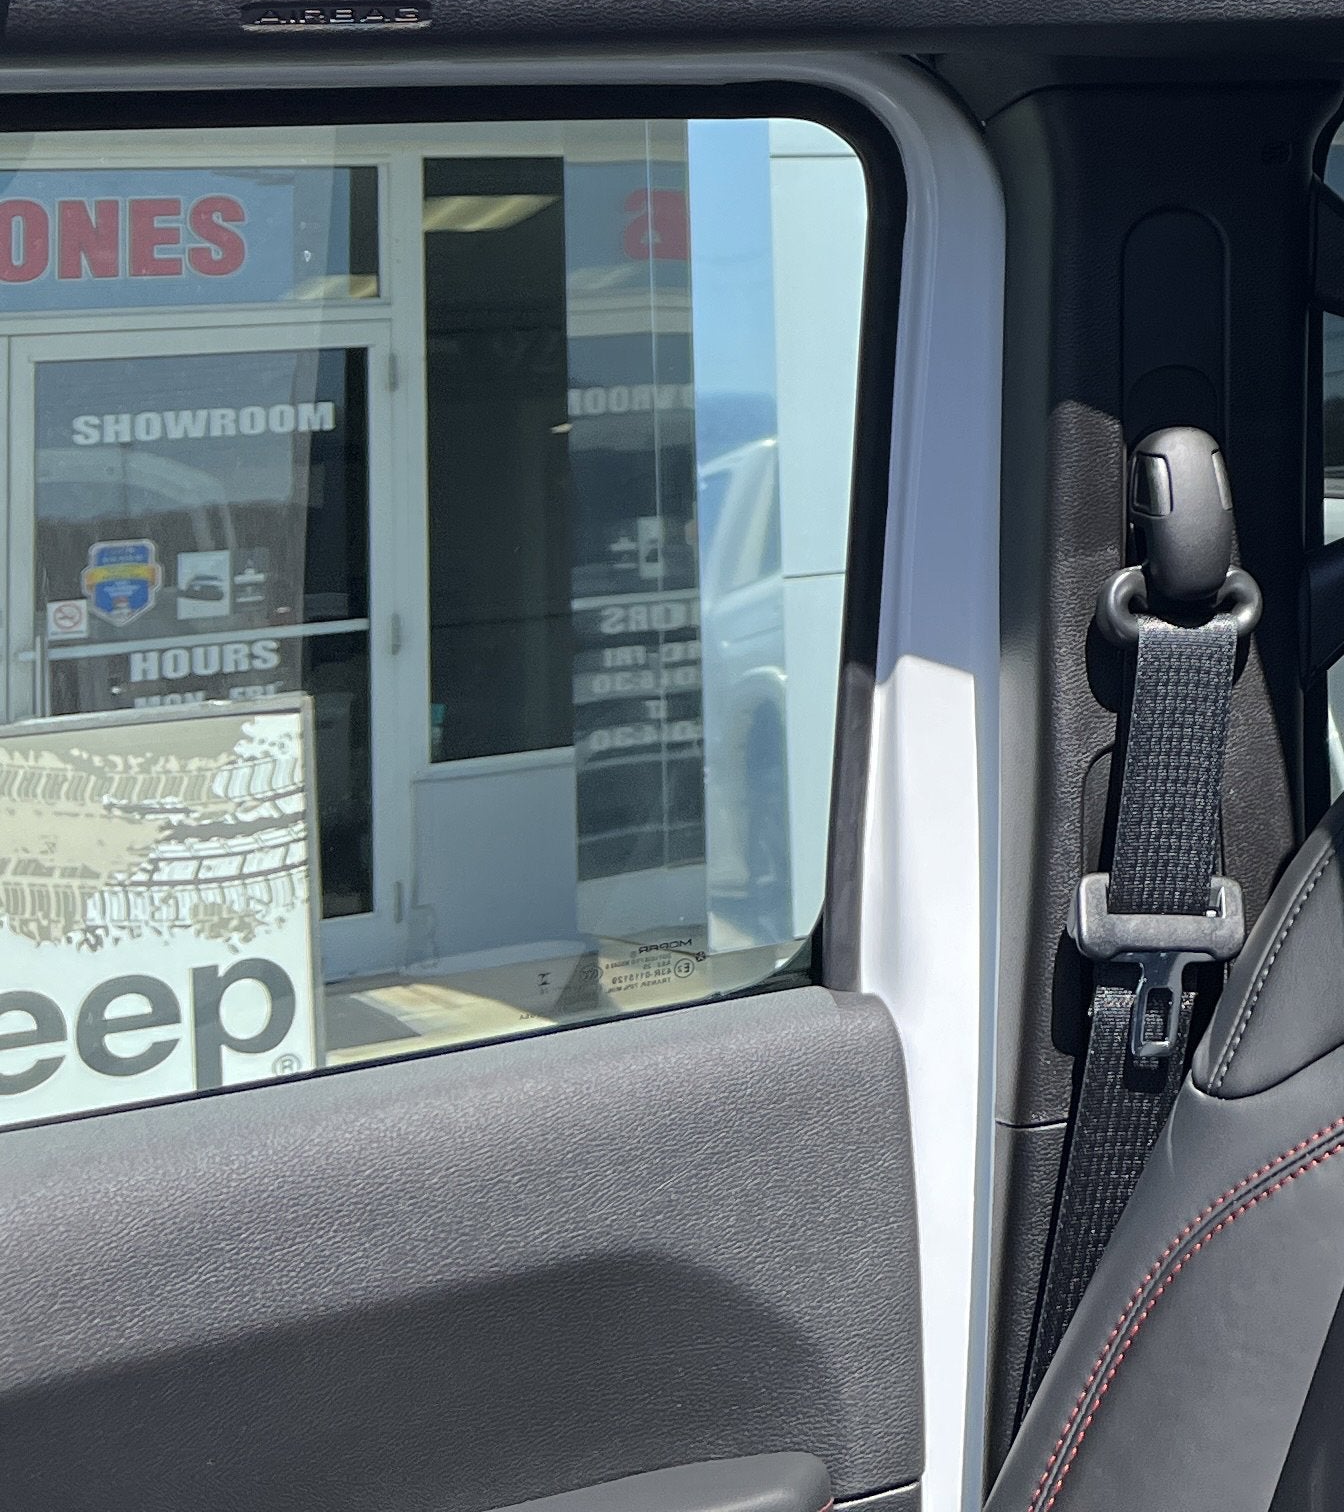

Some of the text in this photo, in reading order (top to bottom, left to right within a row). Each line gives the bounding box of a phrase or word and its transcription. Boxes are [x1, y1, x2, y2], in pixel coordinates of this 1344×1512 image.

[253, 7, 420, 24] AIRBAG
[72, 401, 336, 446] SHOWROOM
[130, 639, 281, 683] HOURS
